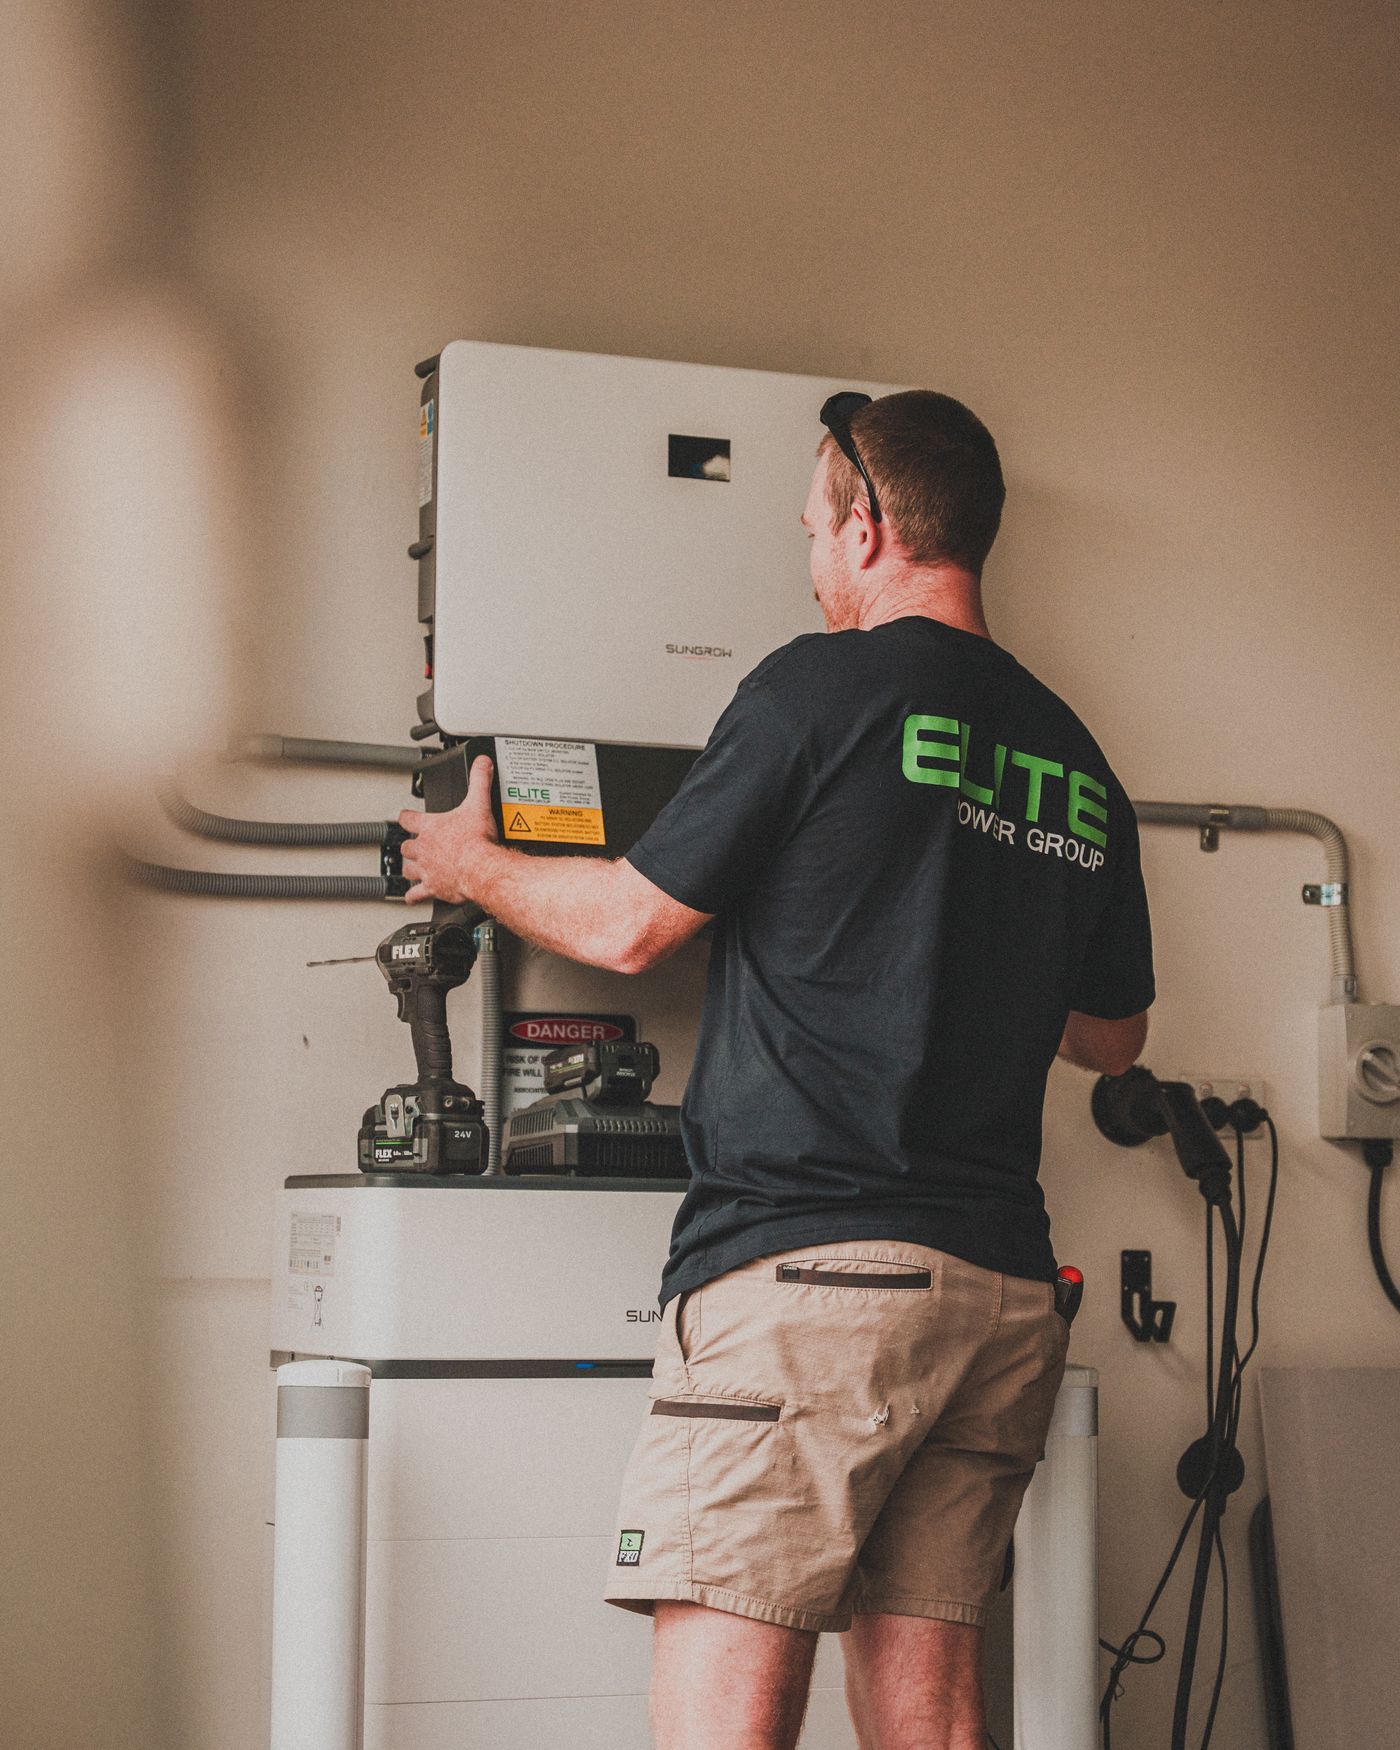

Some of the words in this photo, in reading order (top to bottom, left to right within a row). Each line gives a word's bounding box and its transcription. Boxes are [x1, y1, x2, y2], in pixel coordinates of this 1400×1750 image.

[665, 643, 733, 657] SUNGROW
[504, 739, 544, 747] SHUTDOWN
[545, 742, 585, 751] PROCEDURE
[902, 714, 1107, 848] ELITE
[507, 786, 550, 800] ELITE
[549, 809, 583, 817] WARNING
[957, 800, 1016, 845] OWER
[1026, 828, 1104, 872] GROUP
[392, 944, 420, 960] FLEX
[527, 1023, 605, 1040] DANGER
[522, 1069, 543, 1078] WILL
[454, 1130, 472, 1138] 24V
[375, 1149, 392, 1159] FLEX
